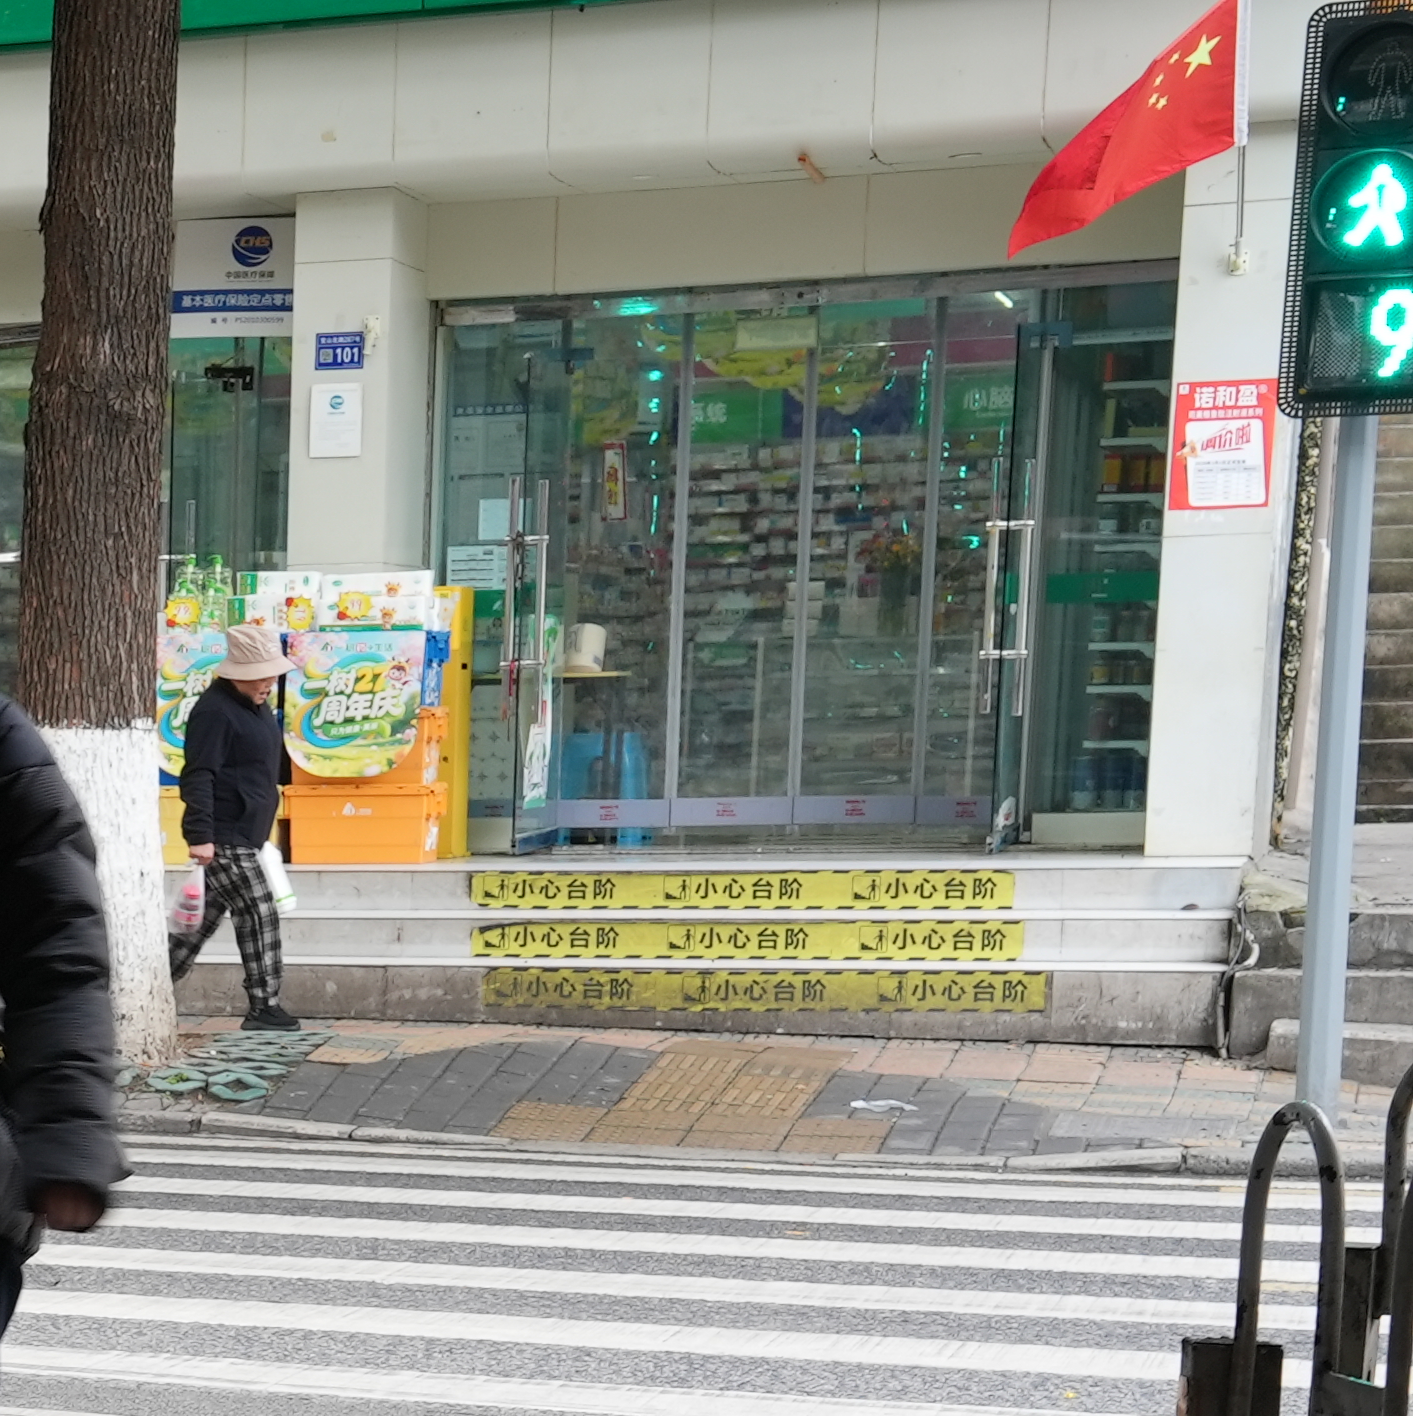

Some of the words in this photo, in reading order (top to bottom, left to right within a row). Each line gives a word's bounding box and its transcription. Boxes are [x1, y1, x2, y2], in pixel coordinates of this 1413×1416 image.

[239, 235, 271, 248] CHS
[225, 270, 276, 280] 中国医疗保障
[1370, 289, 1413, 377] 9
[335, 346, 360, 363] 101
[1194, 384, 1259, 408] 诺和盈
[304, 665, 387, 697] 一树27
[315, 686, 405, 727] 周年庆
[512, 877, 616, 900] 小心台阶
[694, 877, 803, 900] 小心台阶
[884, 877, 998, 900] 小心台阶
[514, 926, 620, 949] 小心台阶
[699, 926, 810, 950] 小心台阶
[892, 927, 1007, 951] 小心台阶
[526, 975, 634, 1000] 小心台阶
[714, 978, 827, 1002] 小心台阶
[911, 979, 1028, 1003] 小心台阶
